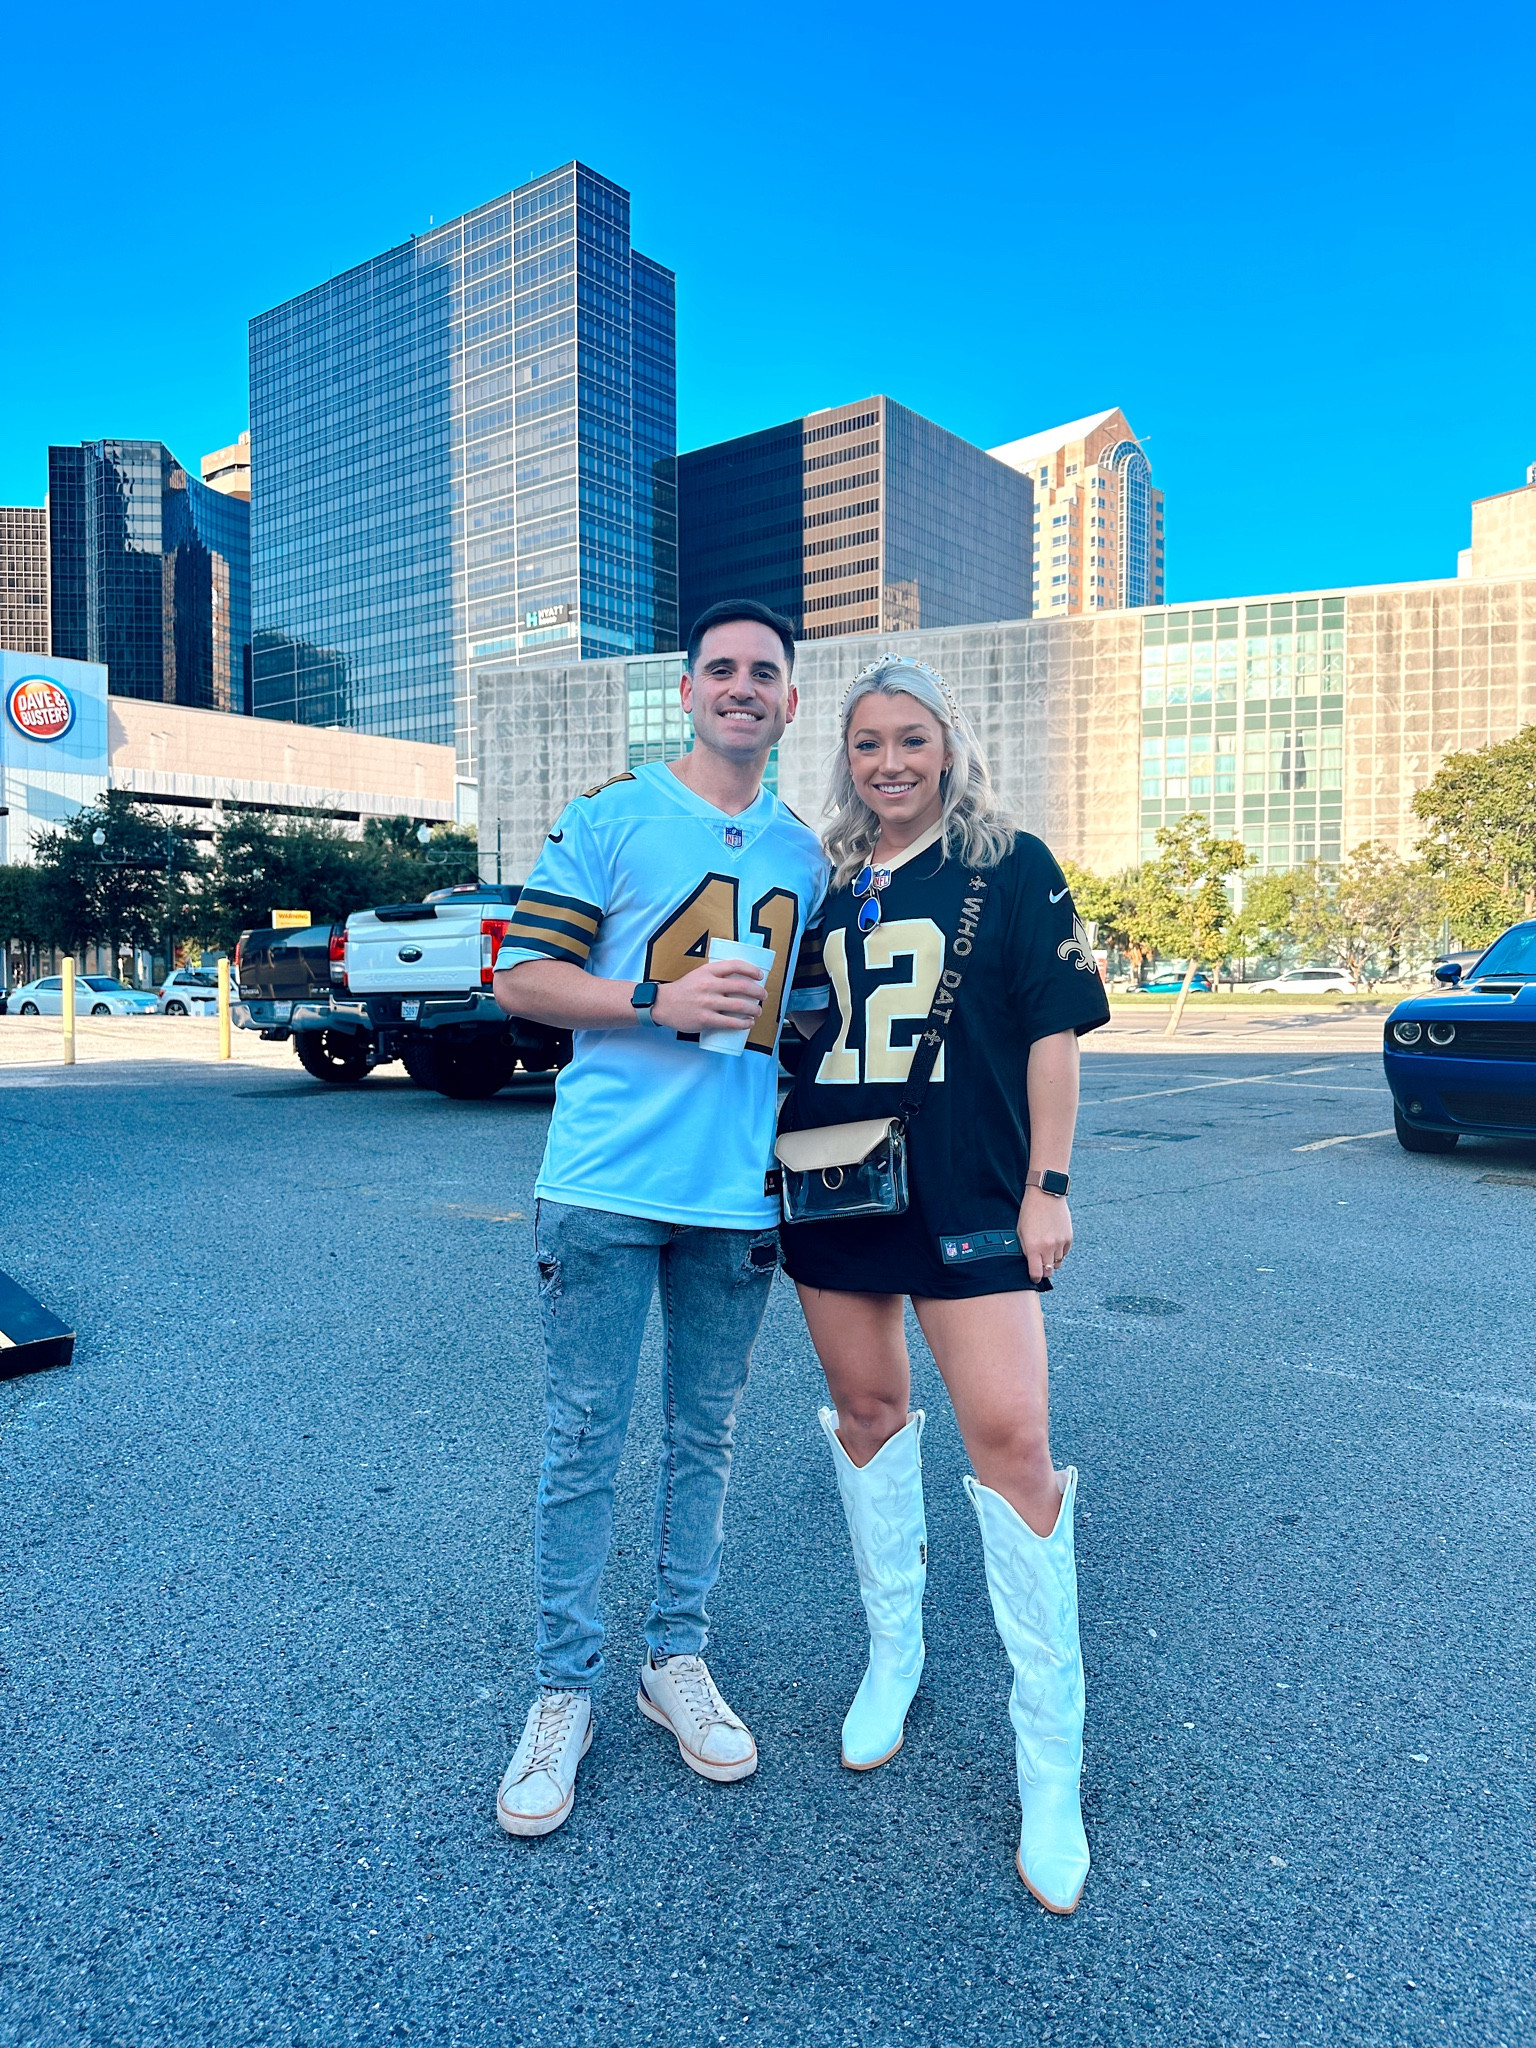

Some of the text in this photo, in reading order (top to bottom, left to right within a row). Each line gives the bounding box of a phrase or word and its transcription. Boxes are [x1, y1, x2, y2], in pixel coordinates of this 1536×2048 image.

[538, 604, 564, 618] HYATT
[18, 691, 66, 711] DAVE &
[643, 872, 799, 1056] 41
[815, 918, 946, 1084] 12
[932, 897, 984, 1024] WHO DAT
